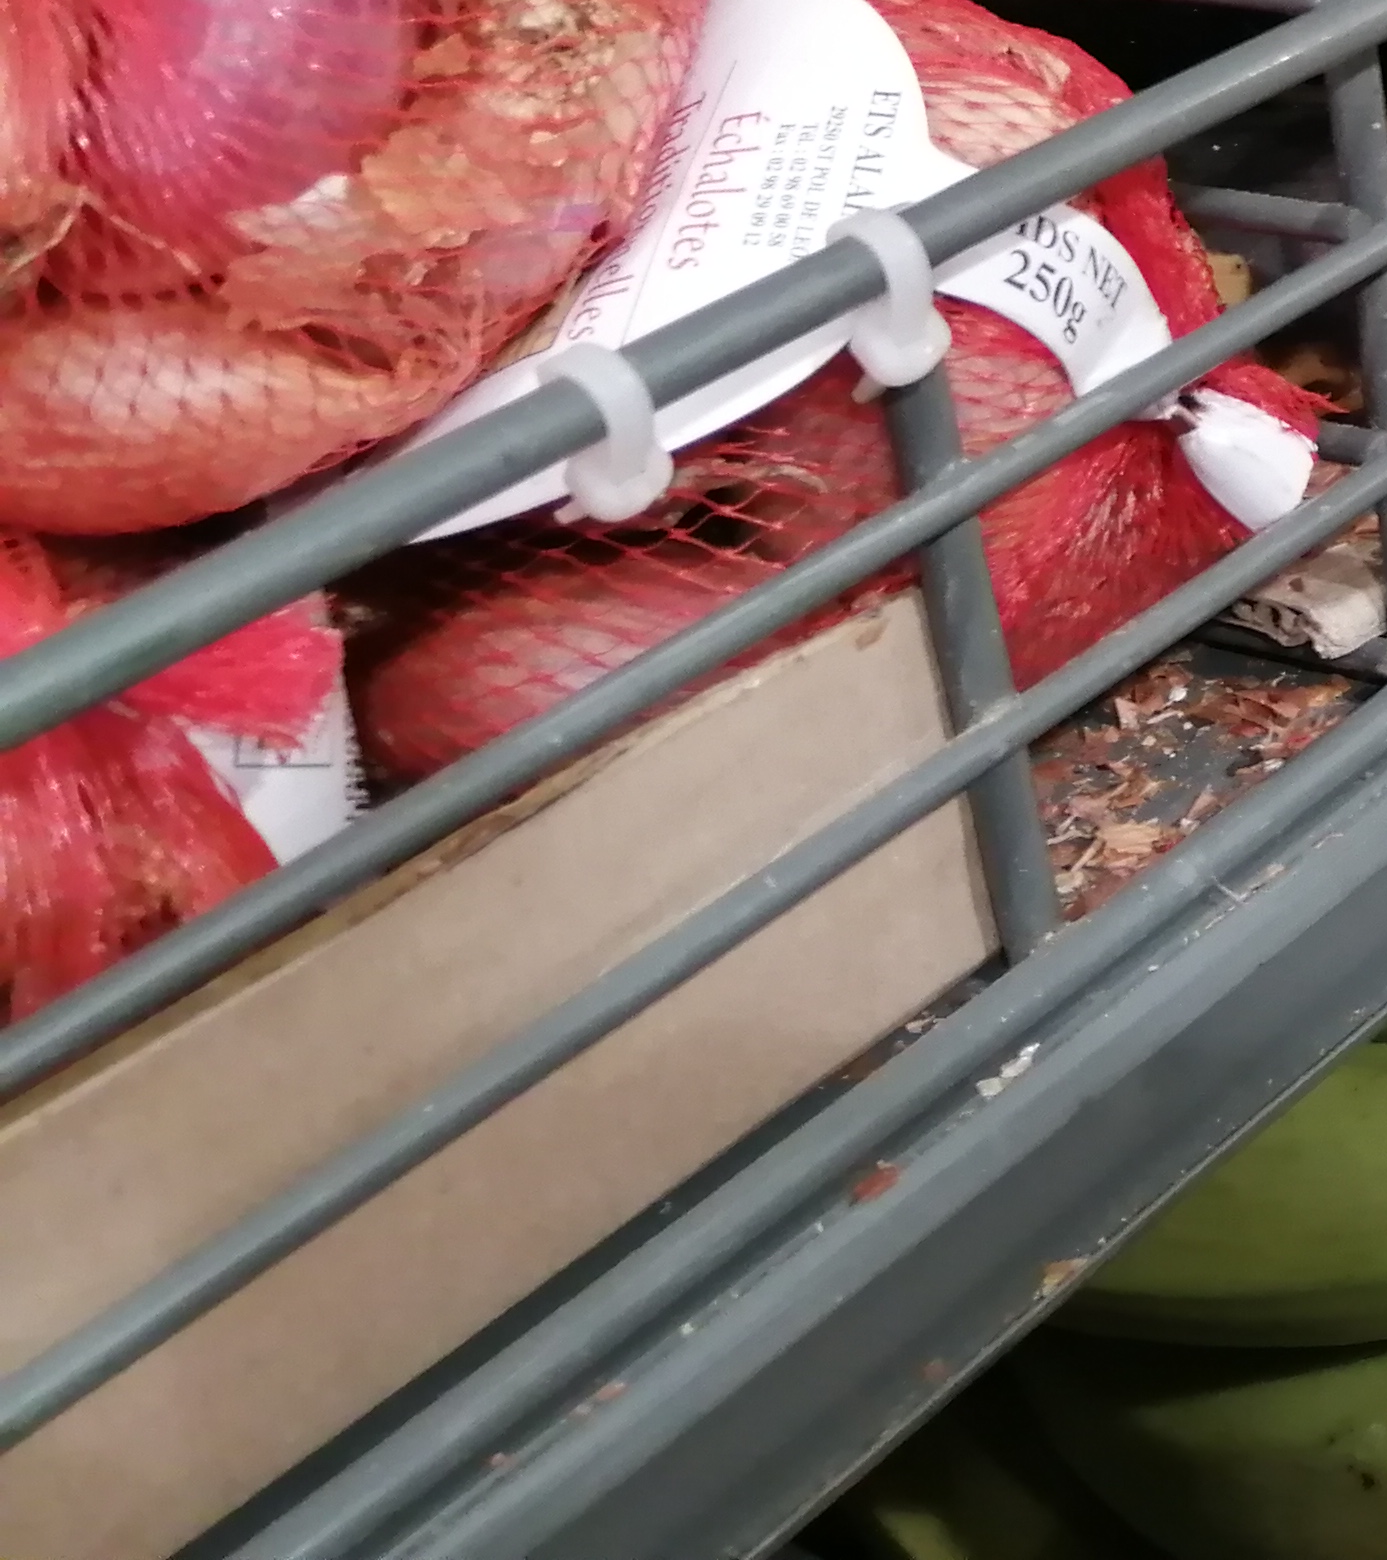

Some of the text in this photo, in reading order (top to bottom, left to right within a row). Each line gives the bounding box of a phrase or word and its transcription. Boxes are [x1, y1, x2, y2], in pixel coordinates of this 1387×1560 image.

[863, 90, 901, 138] ETS
[766, 157, 784, 172] 02
[789, 157, 807, 172] 02
[760, 175, 779, 190] 98
[784, 175, 802, 191] 98
[789, 105, 848, 262] 29250 ST POL DE LEO
[667, 111, 770, 271] Échalotes
[756, 193, 774, 209] 29
[780, 193, 796, 210] 69
[751, 211, 767, 227] 09
[773, 212, 791, 229] 00
[742, 232, 761, 246] 12
[1082, 246, 1127, 308] NET
[1003, 249, 1086, 344] 250g
